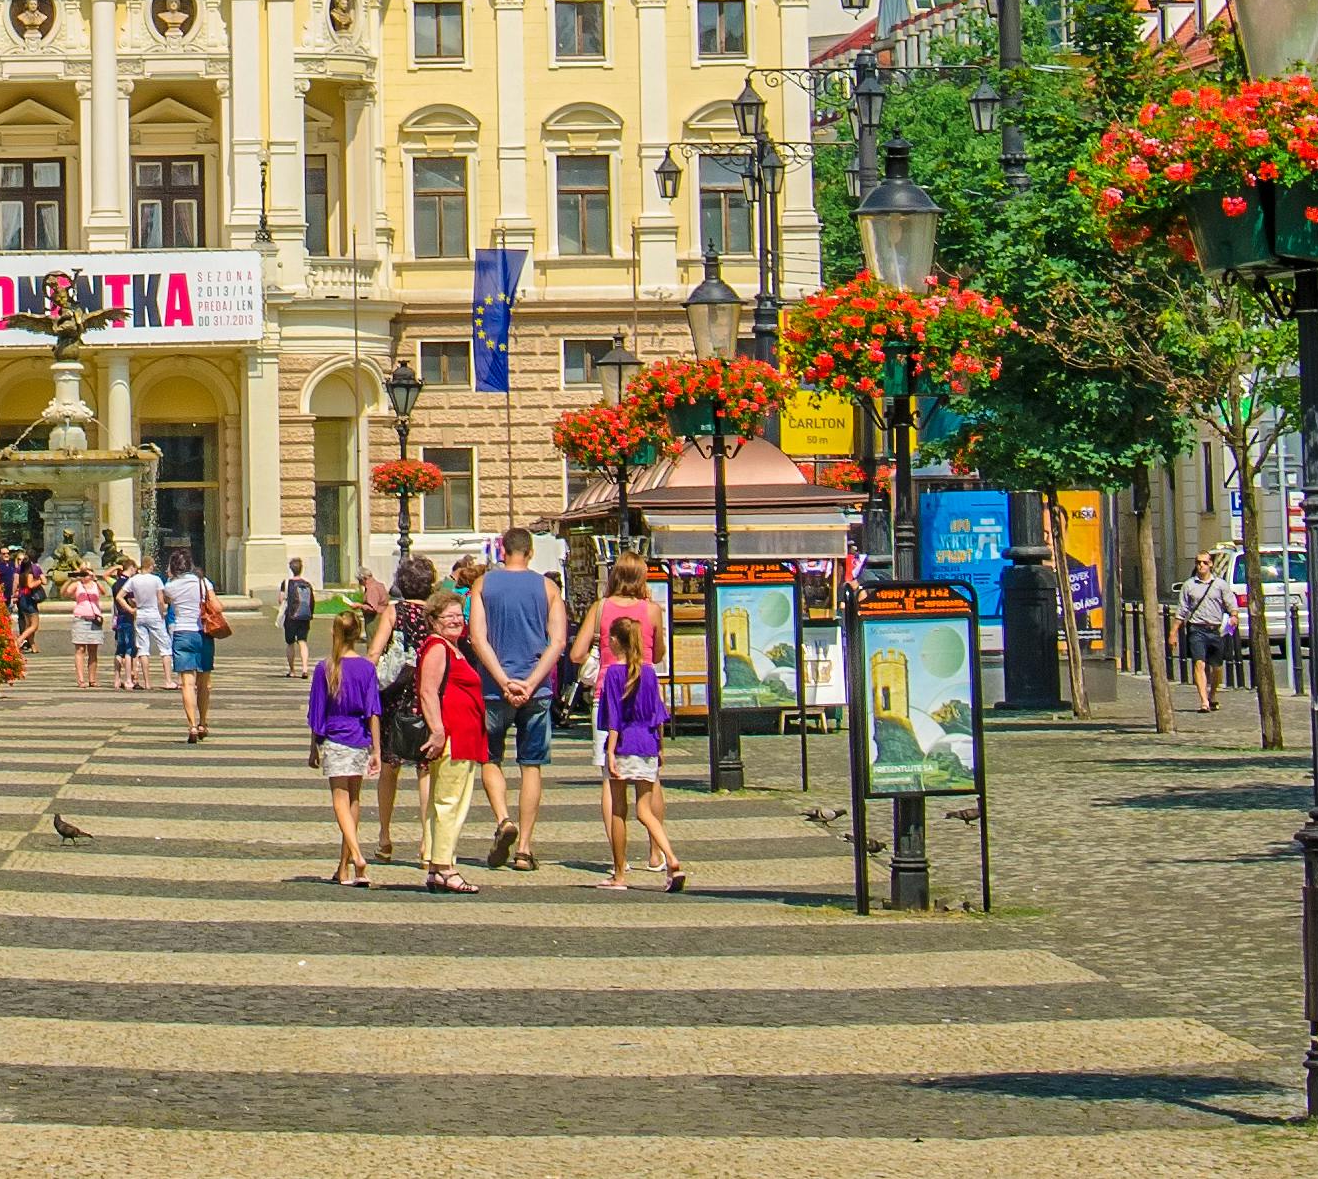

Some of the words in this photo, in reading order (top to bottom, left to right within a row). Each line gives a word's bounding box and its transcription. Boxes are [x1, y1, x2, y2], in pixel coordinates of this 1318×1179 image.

[197, 285, 253, 298] 2013/14
[198, 300, 232, 312] PREDAJ
[236, 300, 254, 311] LEN
[198, 315, 210, 327] DO
[213, 314, 254, 326] 31.7.2013
[788, 417, 845, 429] CARLTON
[806, 435, 818, 444] 50
